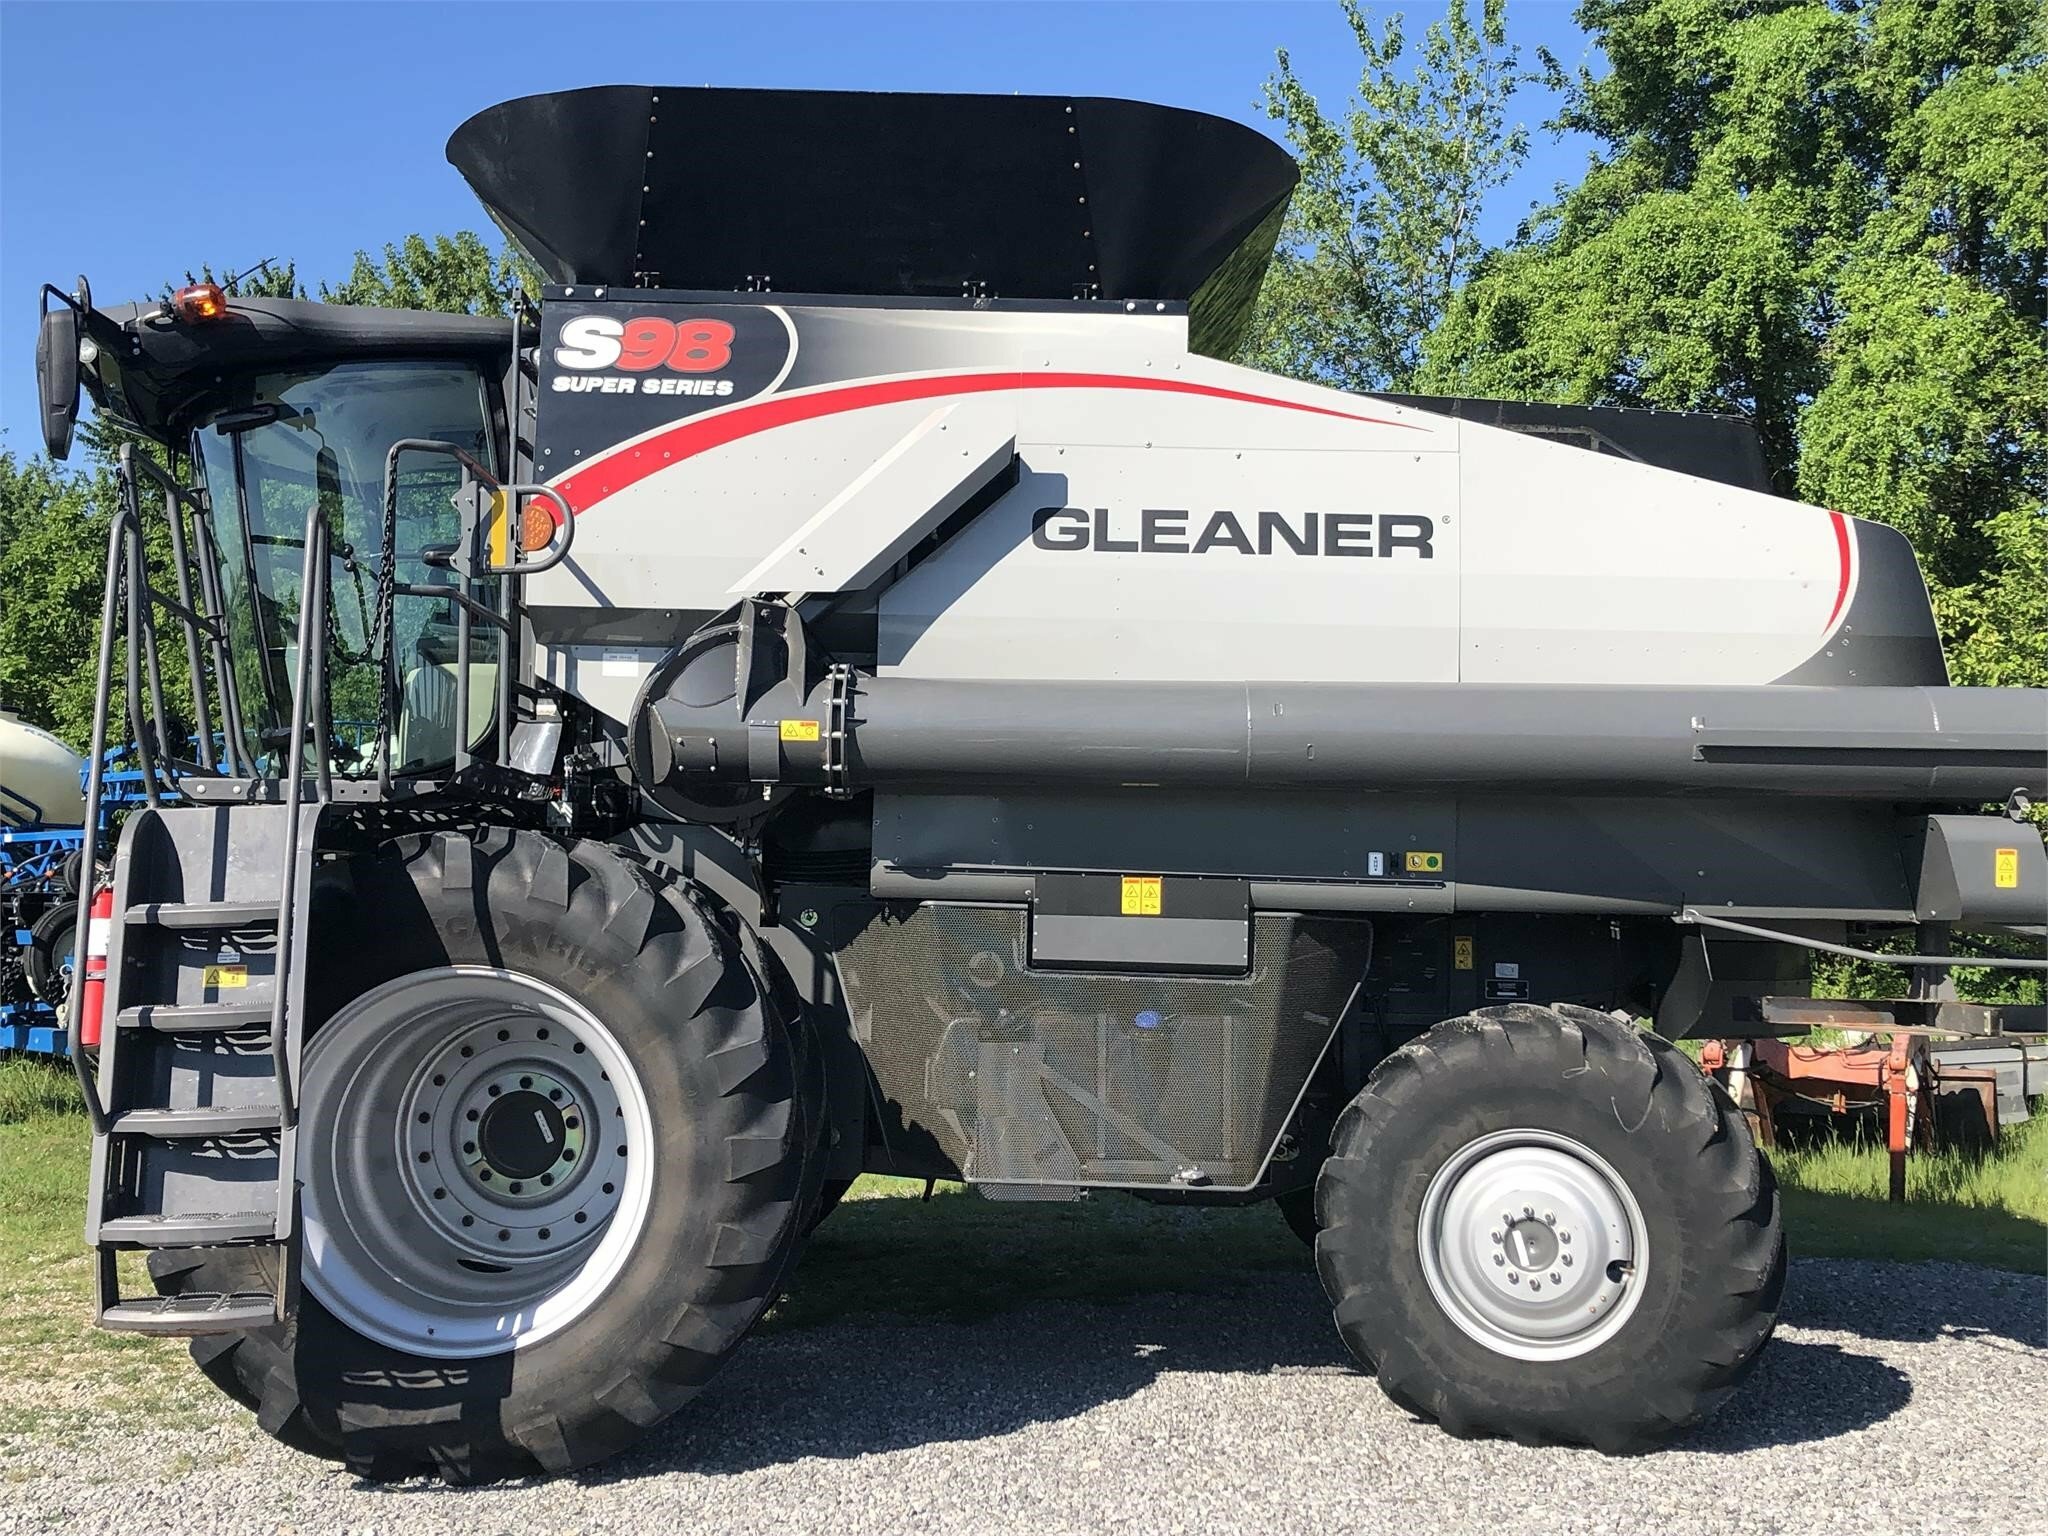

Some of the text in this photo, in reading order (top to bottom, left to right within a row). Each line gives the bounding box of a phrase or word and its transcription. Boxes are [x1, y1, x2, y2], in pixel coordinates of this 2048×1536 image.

[554, 315, 735, 373] S98
[552, 376, 735, 396] SUPER SERIES
[1031, 507, 1434, 559] GLEANER
